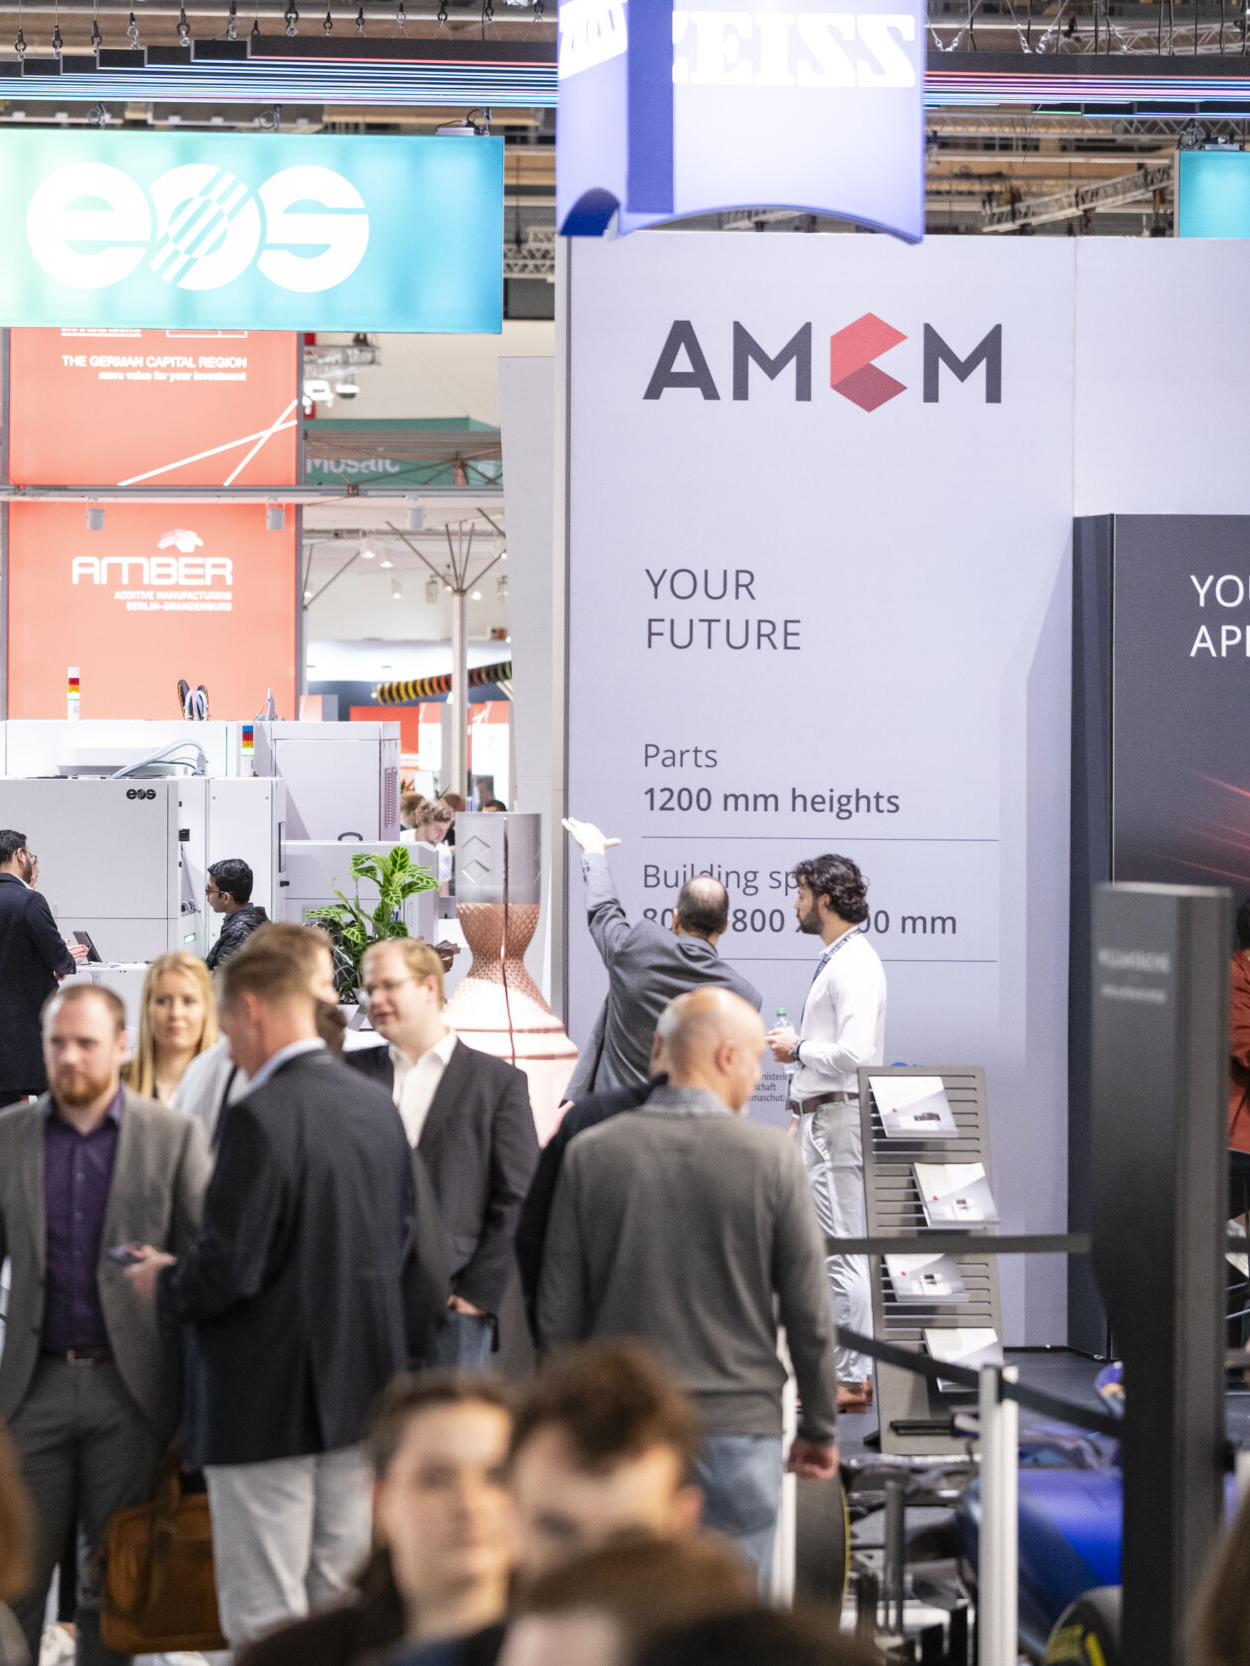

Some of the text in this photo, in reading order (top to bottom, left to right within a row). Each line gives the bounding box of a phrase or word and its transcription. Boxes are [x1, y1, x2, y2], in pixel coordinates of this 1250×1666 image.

[26, 162, 370, 292] eos
[62, 355, 247, 368] THE GERMAN CAPITAL REGION
[643, 312, 1002, 412] AMCM
[72, 556, 233, 586] AMBER
[645, 568, 756, 600] YOUR
[114, 591, 232, 601] ADDITIVE MANUFACTURING
[1190, 574, 1250, 608] YO
[647, 618, 801, 650] FUTURE
[643, 744, 718, 768] Parts
[126, 789, 157, 800] eos
[644, 787, 900, 820] 1200 mm heights
[732, 908, 785, 933] 800
[901, 915, 956, 934] mm
